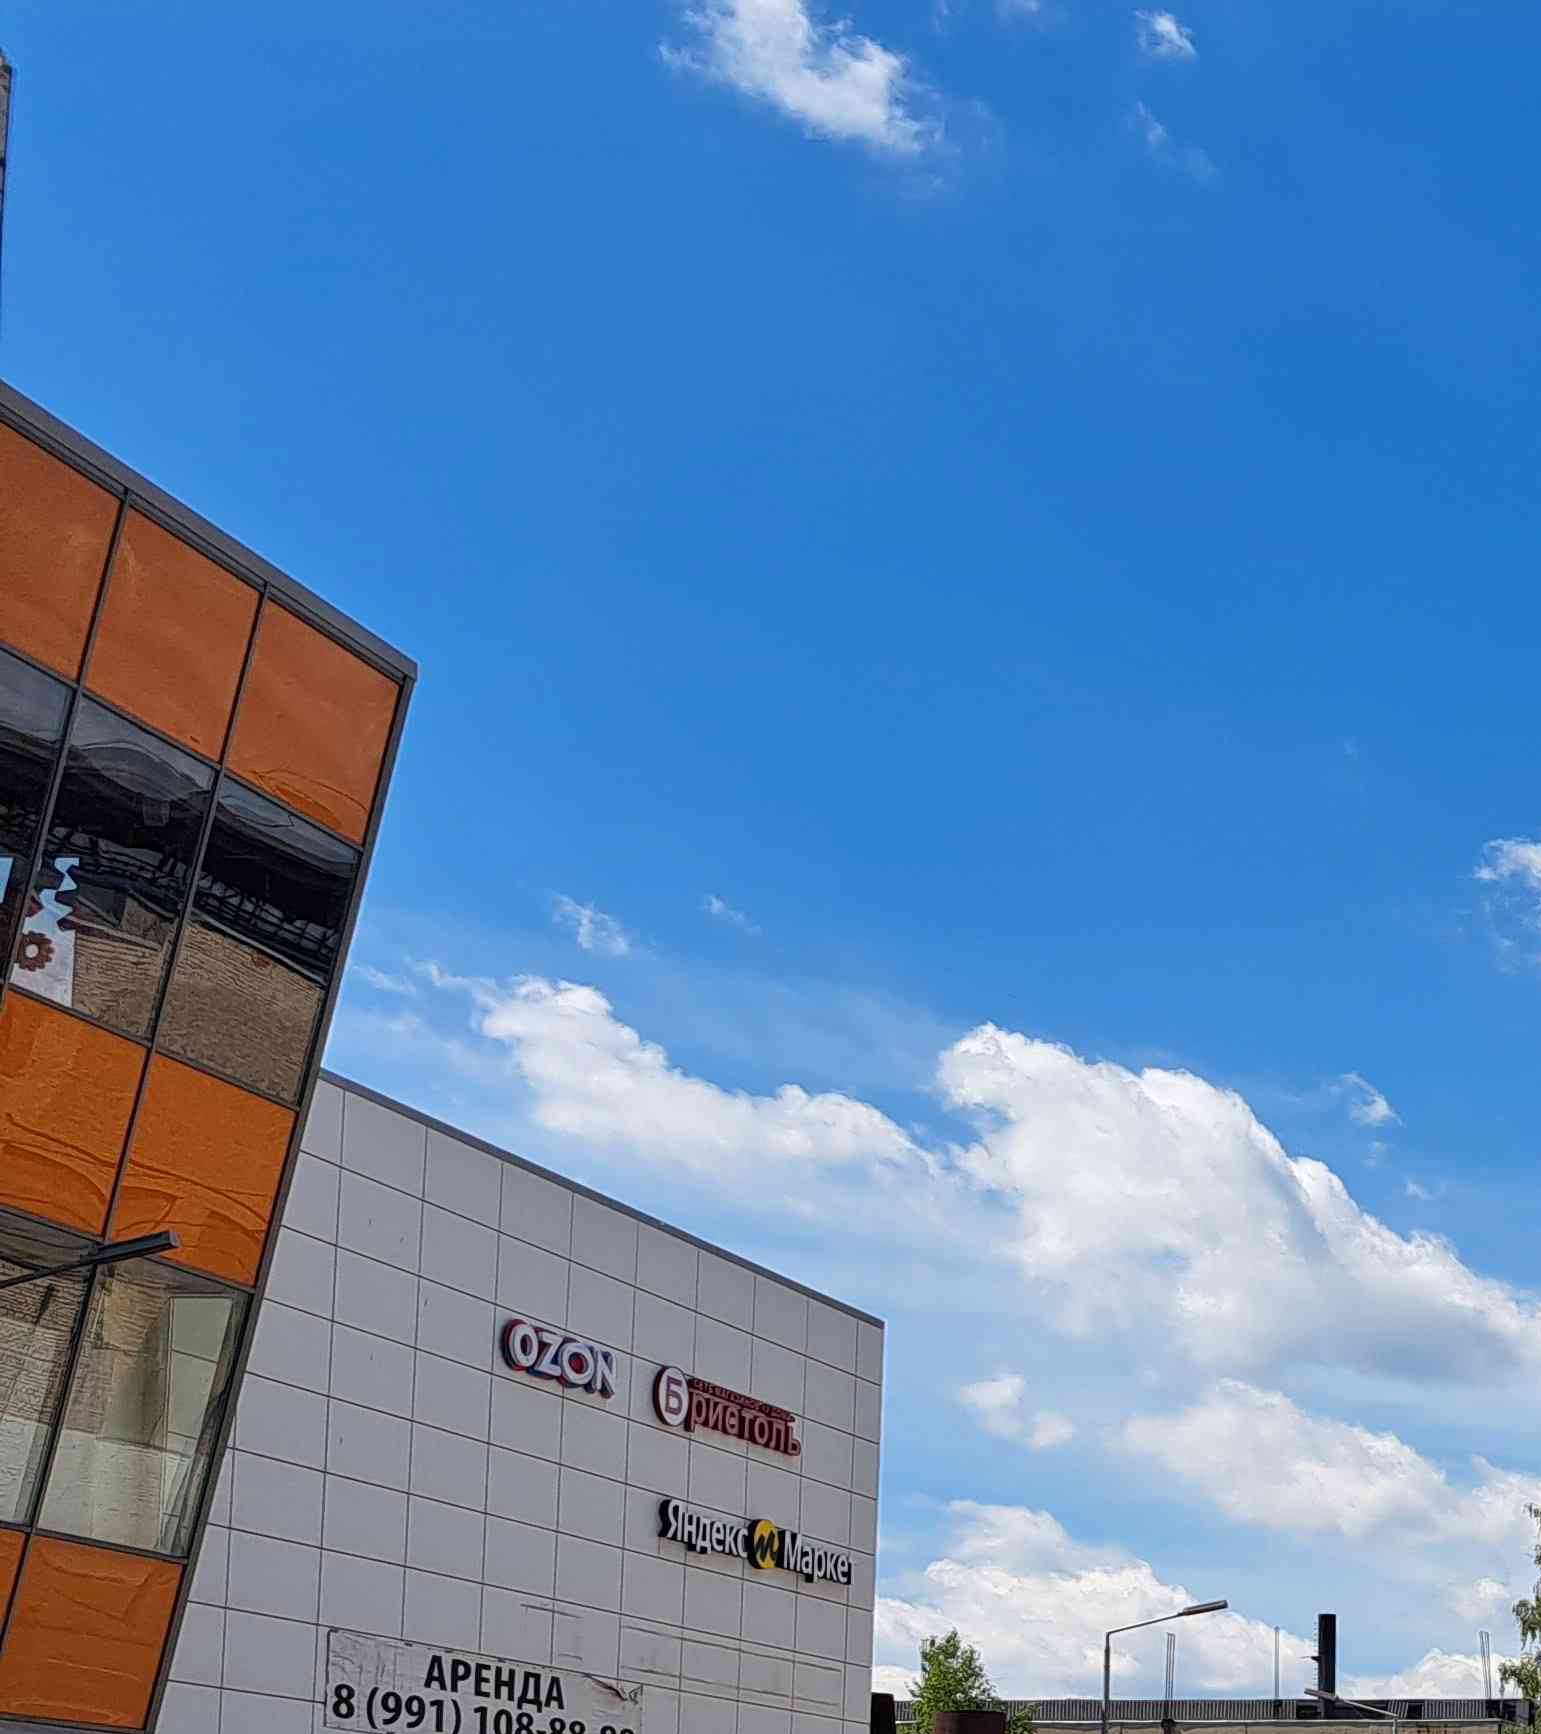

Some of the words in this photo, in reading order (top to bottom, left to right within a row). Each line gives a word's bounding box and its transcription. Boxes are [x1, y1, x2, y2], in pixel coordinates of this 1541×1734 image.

[503, 1319, 616, 1398] OZON
[664, 1499, 749, 1558] Яндекс
[782, 1530, 855, 1584] Маркет
[331, 1683, 356, 1720] 8
[423, 1654, 565, 1712] АРЕНДА
